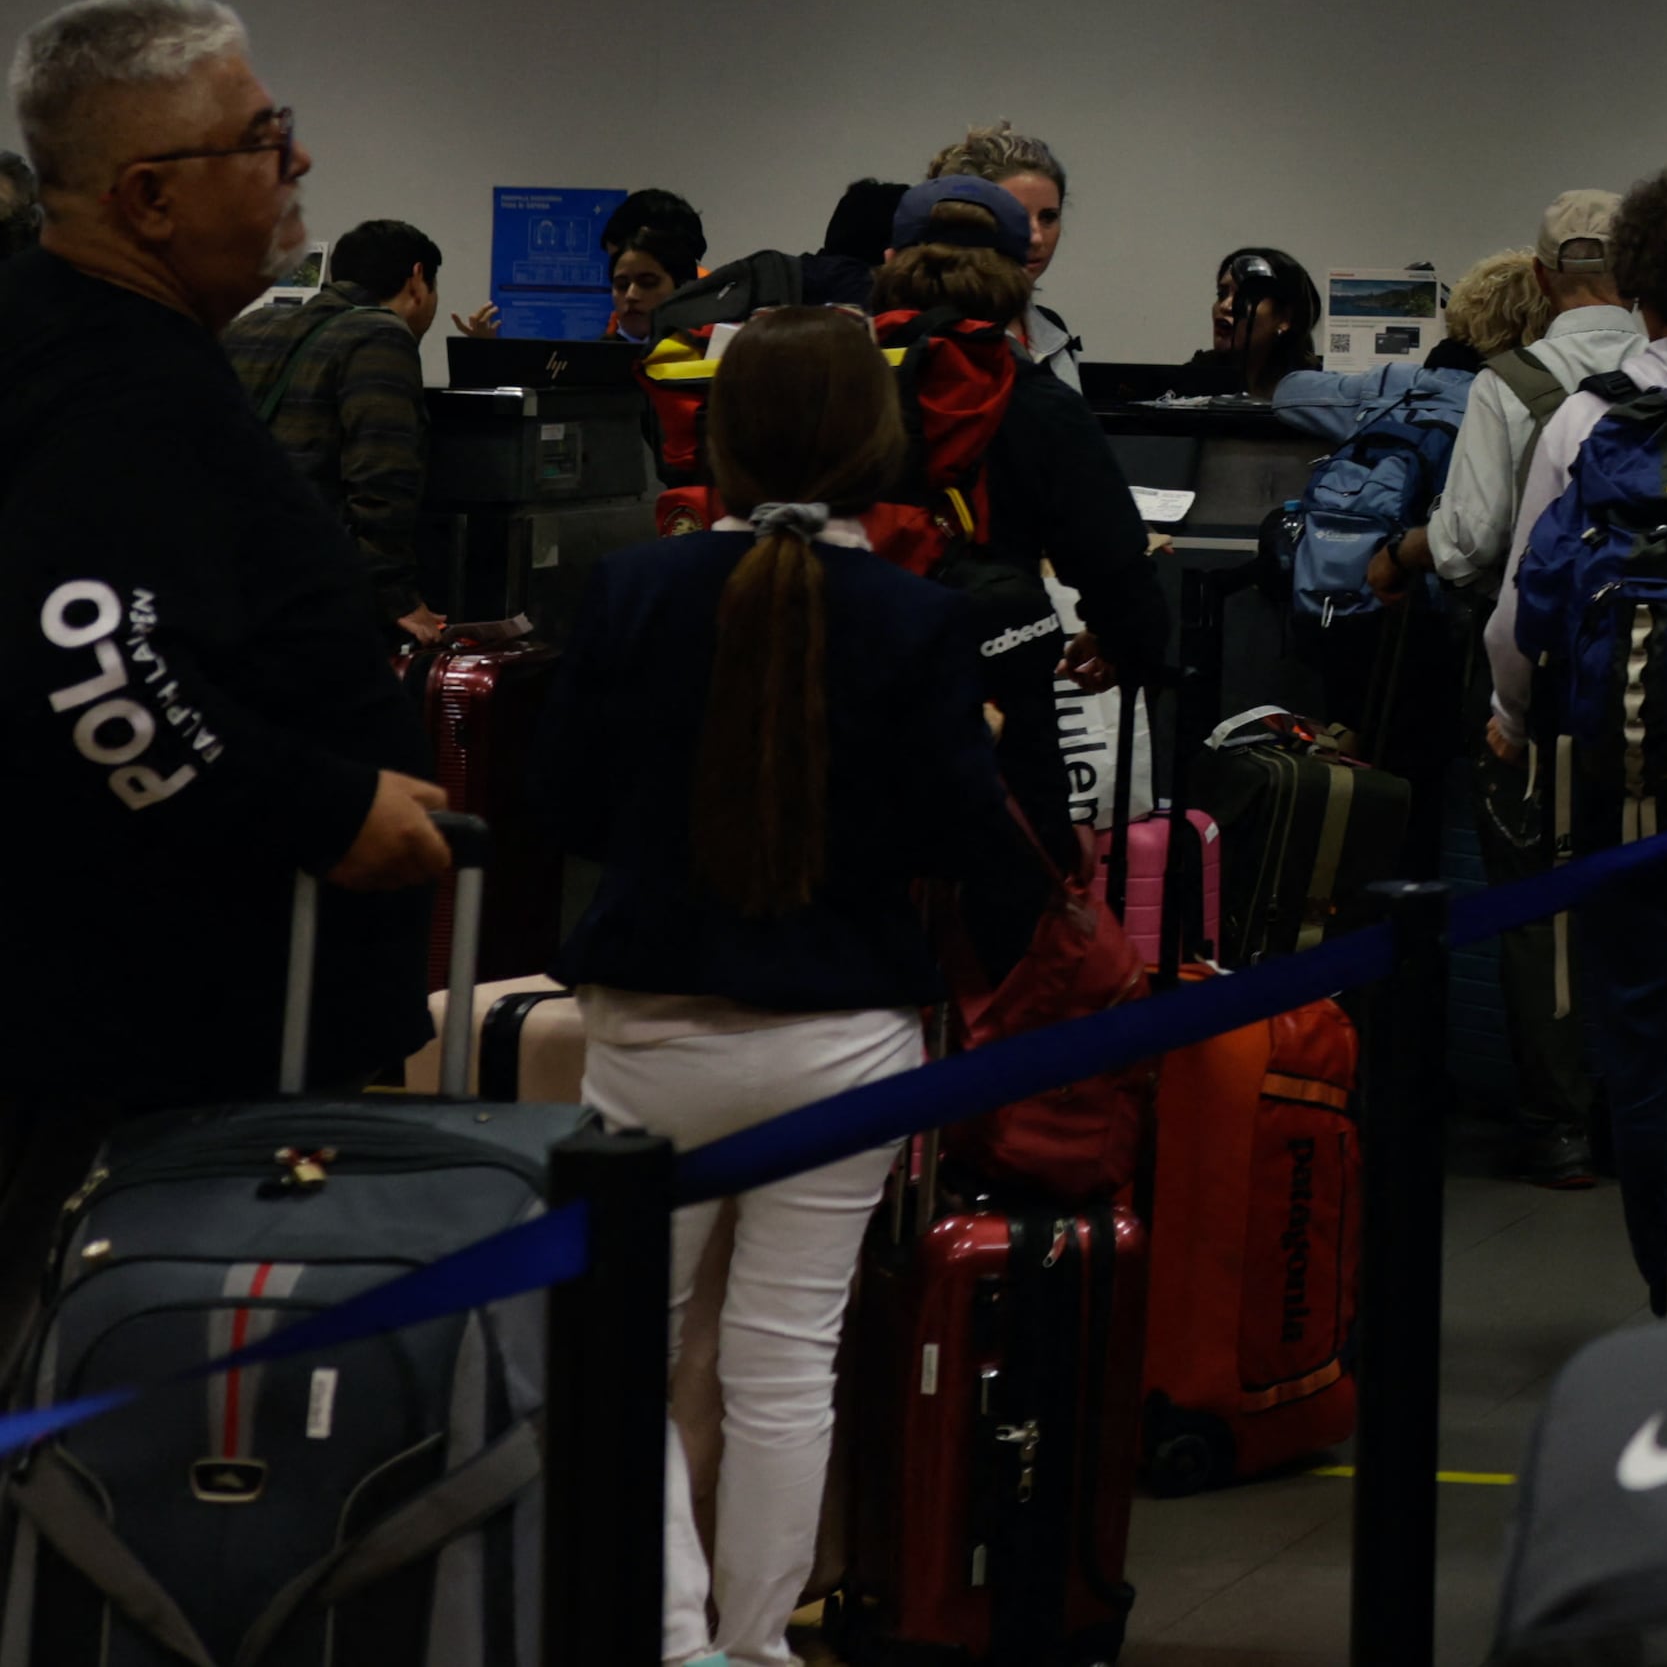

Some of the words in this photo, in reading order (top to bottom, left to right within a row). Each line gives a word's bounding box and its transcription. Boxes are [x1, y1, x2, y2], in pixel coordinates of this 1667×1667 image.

[40, 578, 199, 812] POLO
[980, 613, 1059, 657] cabeau
[1281, 1137, 1315, 1343] patagonia
